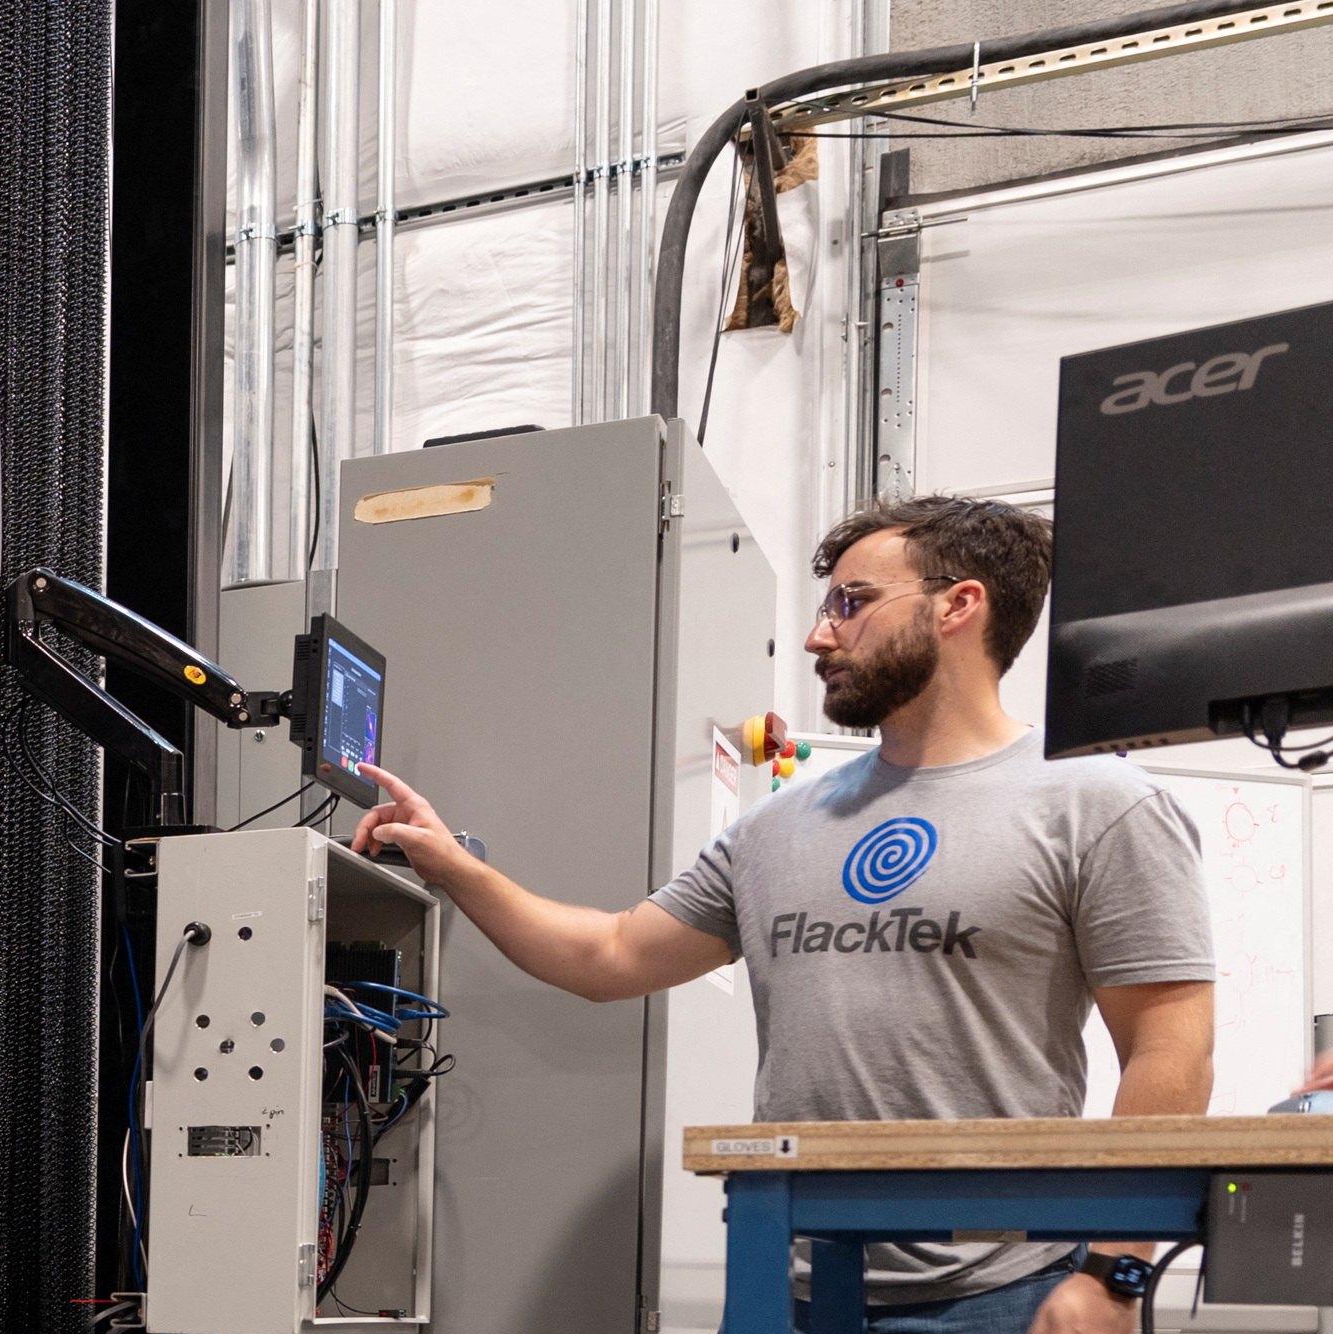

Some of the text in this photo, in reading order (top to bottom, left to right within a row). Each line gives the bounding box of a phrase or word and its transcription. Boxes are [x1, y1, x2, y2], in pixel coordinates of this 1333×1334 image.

[1100, 341, 1290, 416] acer
[770, 907, 982, 959] FlackTek
[716, 1142, 771, 1152] GLOVES
[1290, 1213, 1305, 1267] BELKIN
